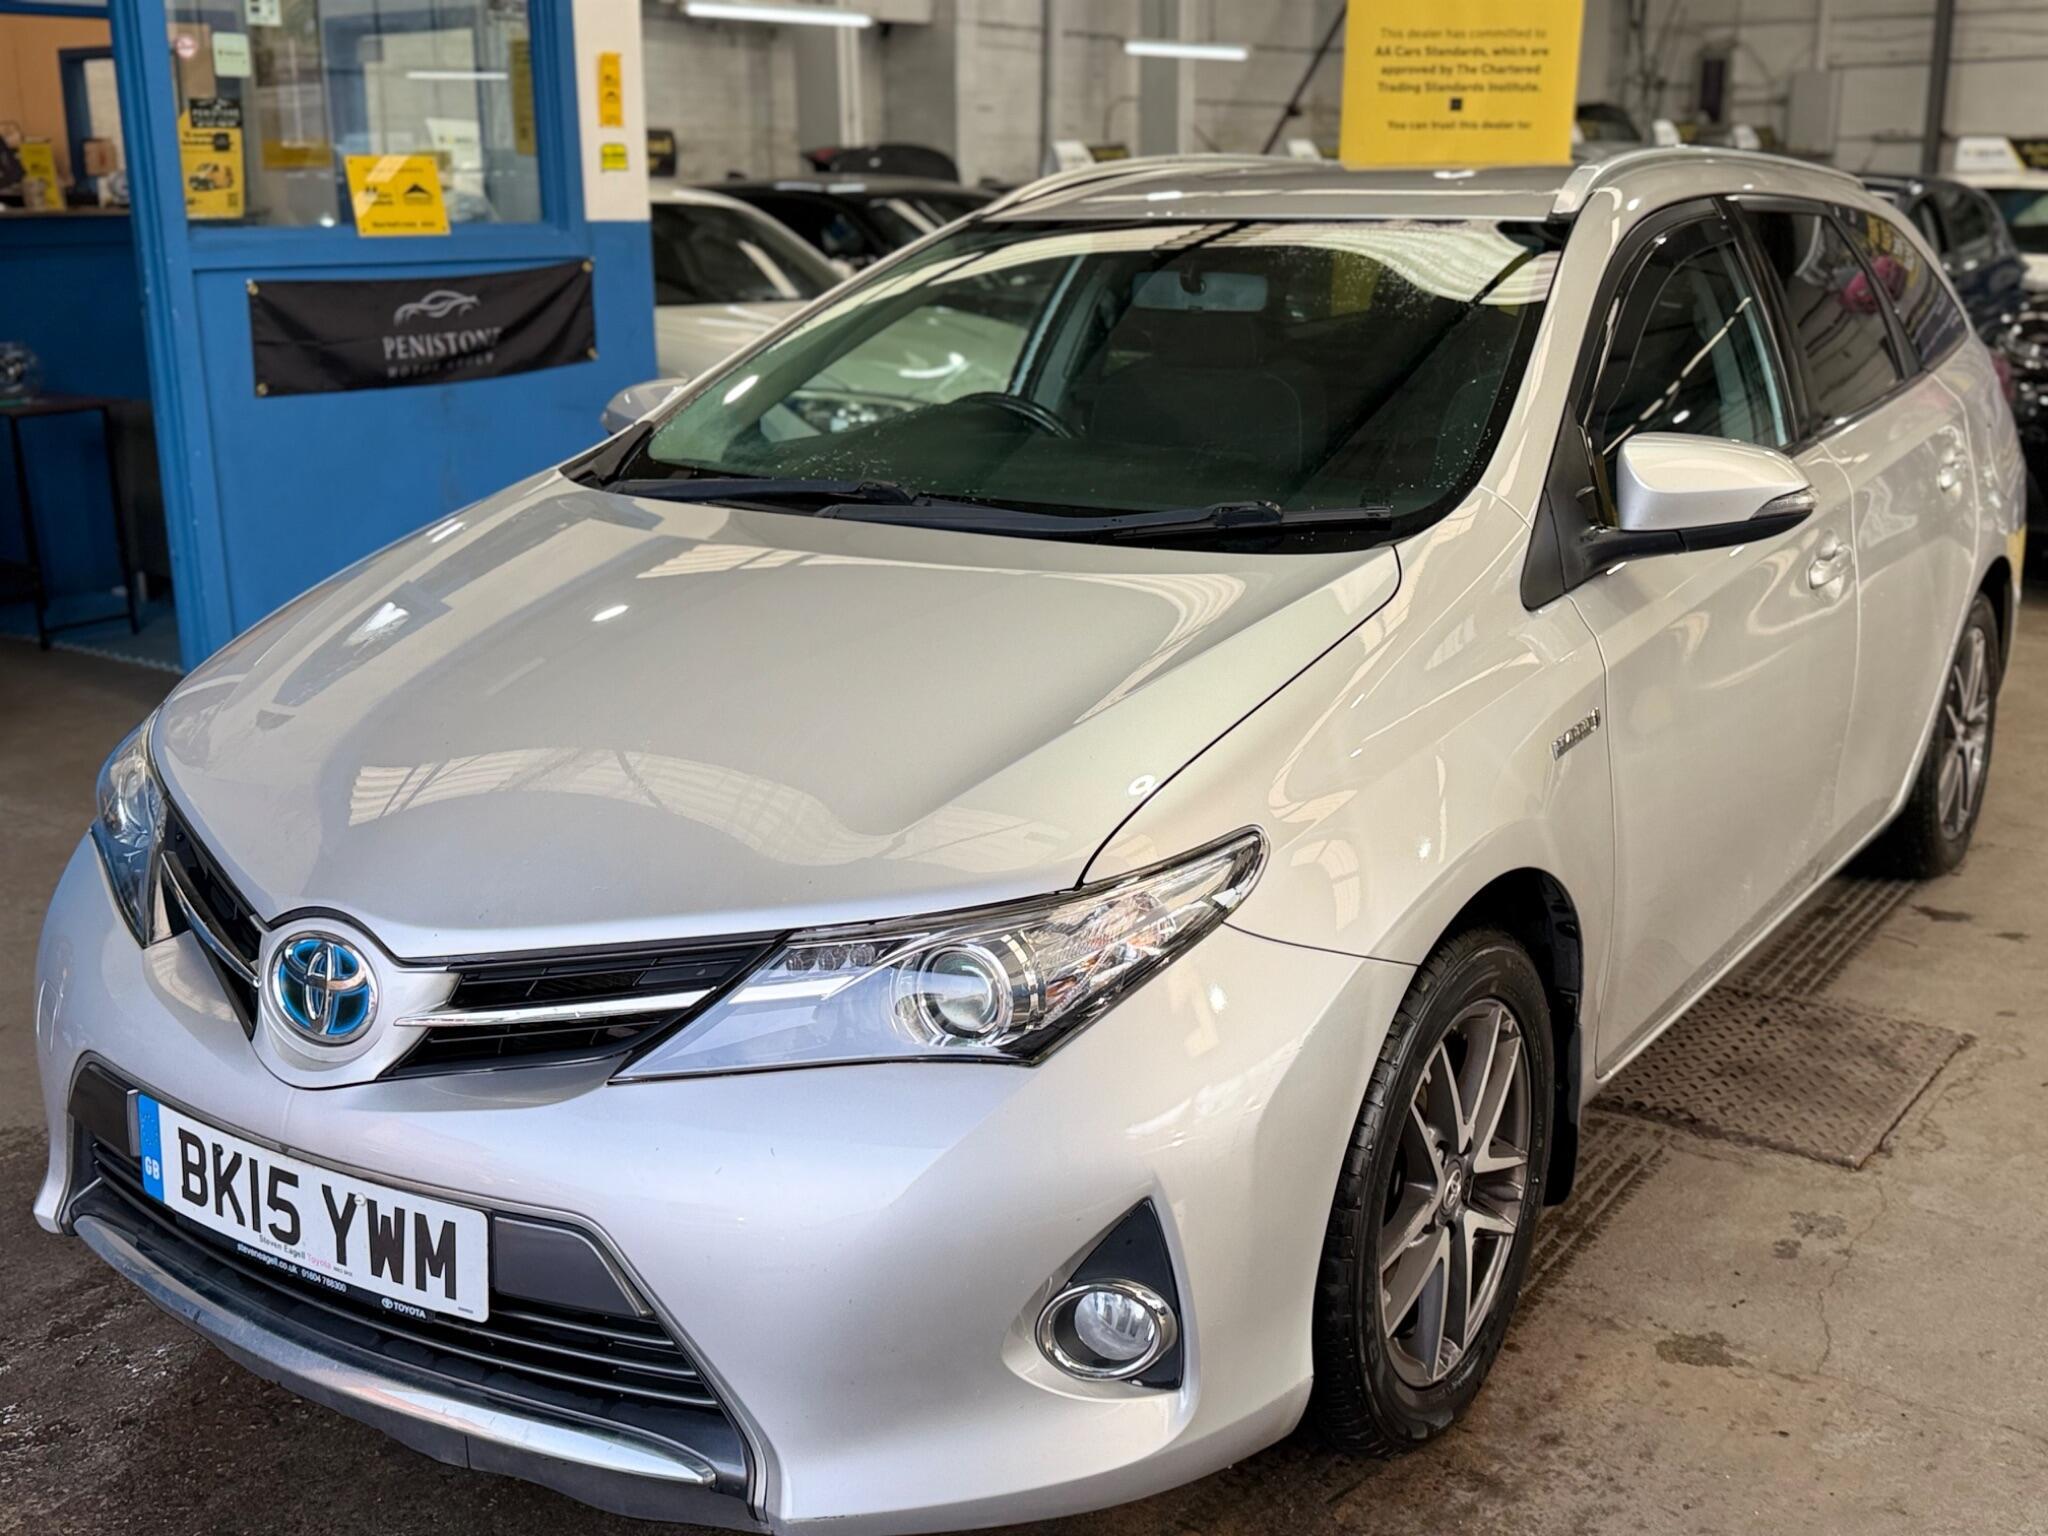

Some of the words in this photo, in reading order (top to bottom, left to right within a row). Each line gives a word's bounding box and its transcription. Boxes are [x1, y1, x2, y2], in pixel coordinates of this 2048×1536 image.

[1381, 26, 1403, 38] This
[1407, 27, 1442, 38] dealer
[1445, 27, 1465, 38] has
[1469, 28, 1532, 39] committed
[1535, 28, 1547, 39] to
[1375, 45, 1391, 56] AA
[1395, 45, 1421, 56] Cars
[1493, 46, 1526, 57] which
[1531, 48, 1549, 57] are
[1381, 65, 1436, 77] approved
[1438, 65, 1452, 77] by
[1457, 64, 1477, 75] The
[1481, 64, 1541, 75] Chartered
[1378, 81, 1421, 94] Trading
[1425, 81, 1484, 93] Standards
[1387, 119, 1406, 130] You
[1409, 121, 1428, 130] can
[1431, 119, 1456, 130] trust
[1460, 119, 1478, 130] this
[1481, 119, 1514, 130] dealer
[144, 1155, 160, 1180] GB
[178, 1127, 301, 1246] BK15
[321, 1183, 457, 1301] YWM
[259, 1234, 283, 1250] Steven
[283, 1243, 306, 1260] Eagell
[306, 1251, 332, 1270] Toyota
[394, 1301, 427, 1319] TOYOTA
